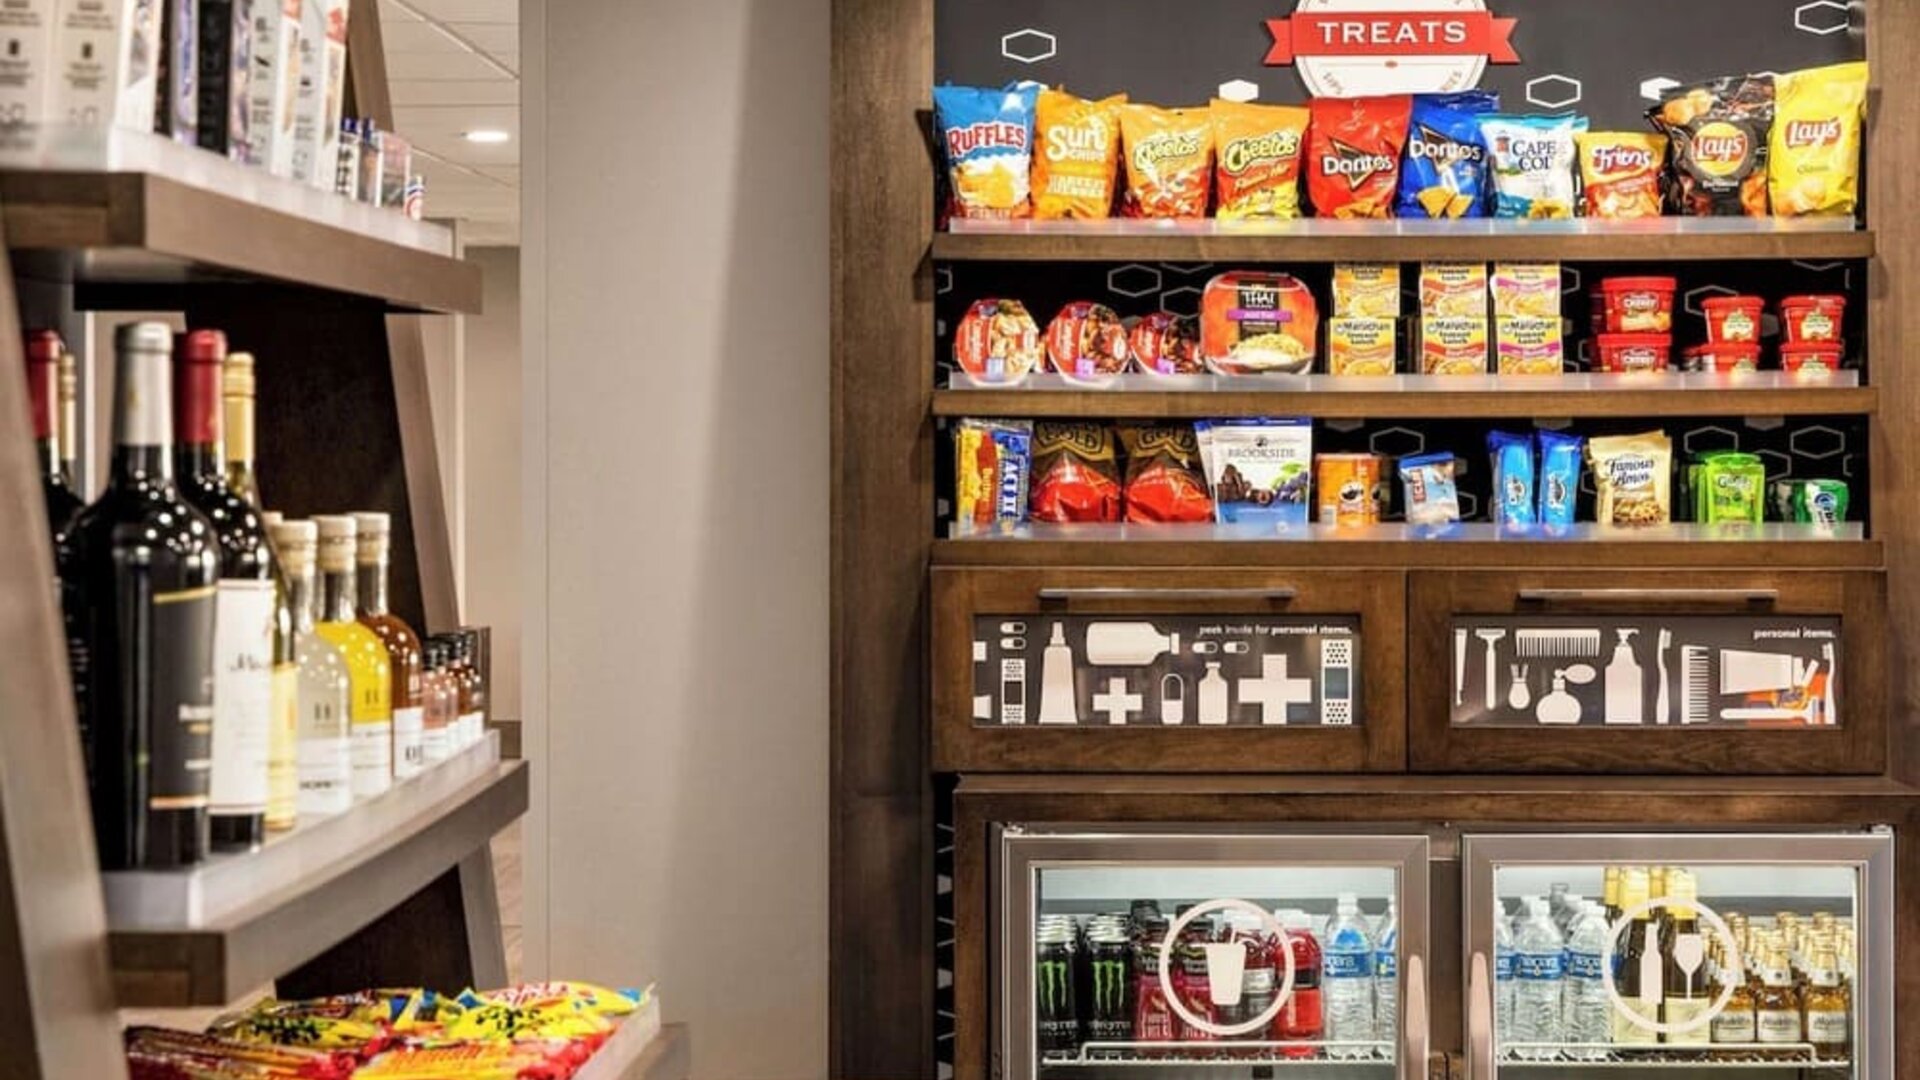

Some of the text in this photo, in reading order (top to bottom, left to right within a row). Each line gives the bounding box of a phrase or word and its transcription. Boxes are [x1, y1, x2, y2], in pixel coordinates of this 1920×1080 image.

[1317, 21, 1466, 43] TREATS
[947, 121, 1026, 158] RUFFLES
[1512, 140, 1557, 157] CAPE
[1225, 133, 1298, 173] Cheetos
[1410, 138, 1482, 161] Doritos
[1594, 145, 1651, 172] Fritos
[1323, 154, 1394, 176] Doritos
[1241, 290, 1275, 305] THAI
[1228, 448, 1296, 457] BROOKSIDE
[1605, 456, 1655, 475] Famous
[1612, 471, 1650, 486] Amos
[1255, 624, 1269, 634] for
[1271, 624, 1317, 636] personal
[1754, 627, 1836, 640] personal items.
